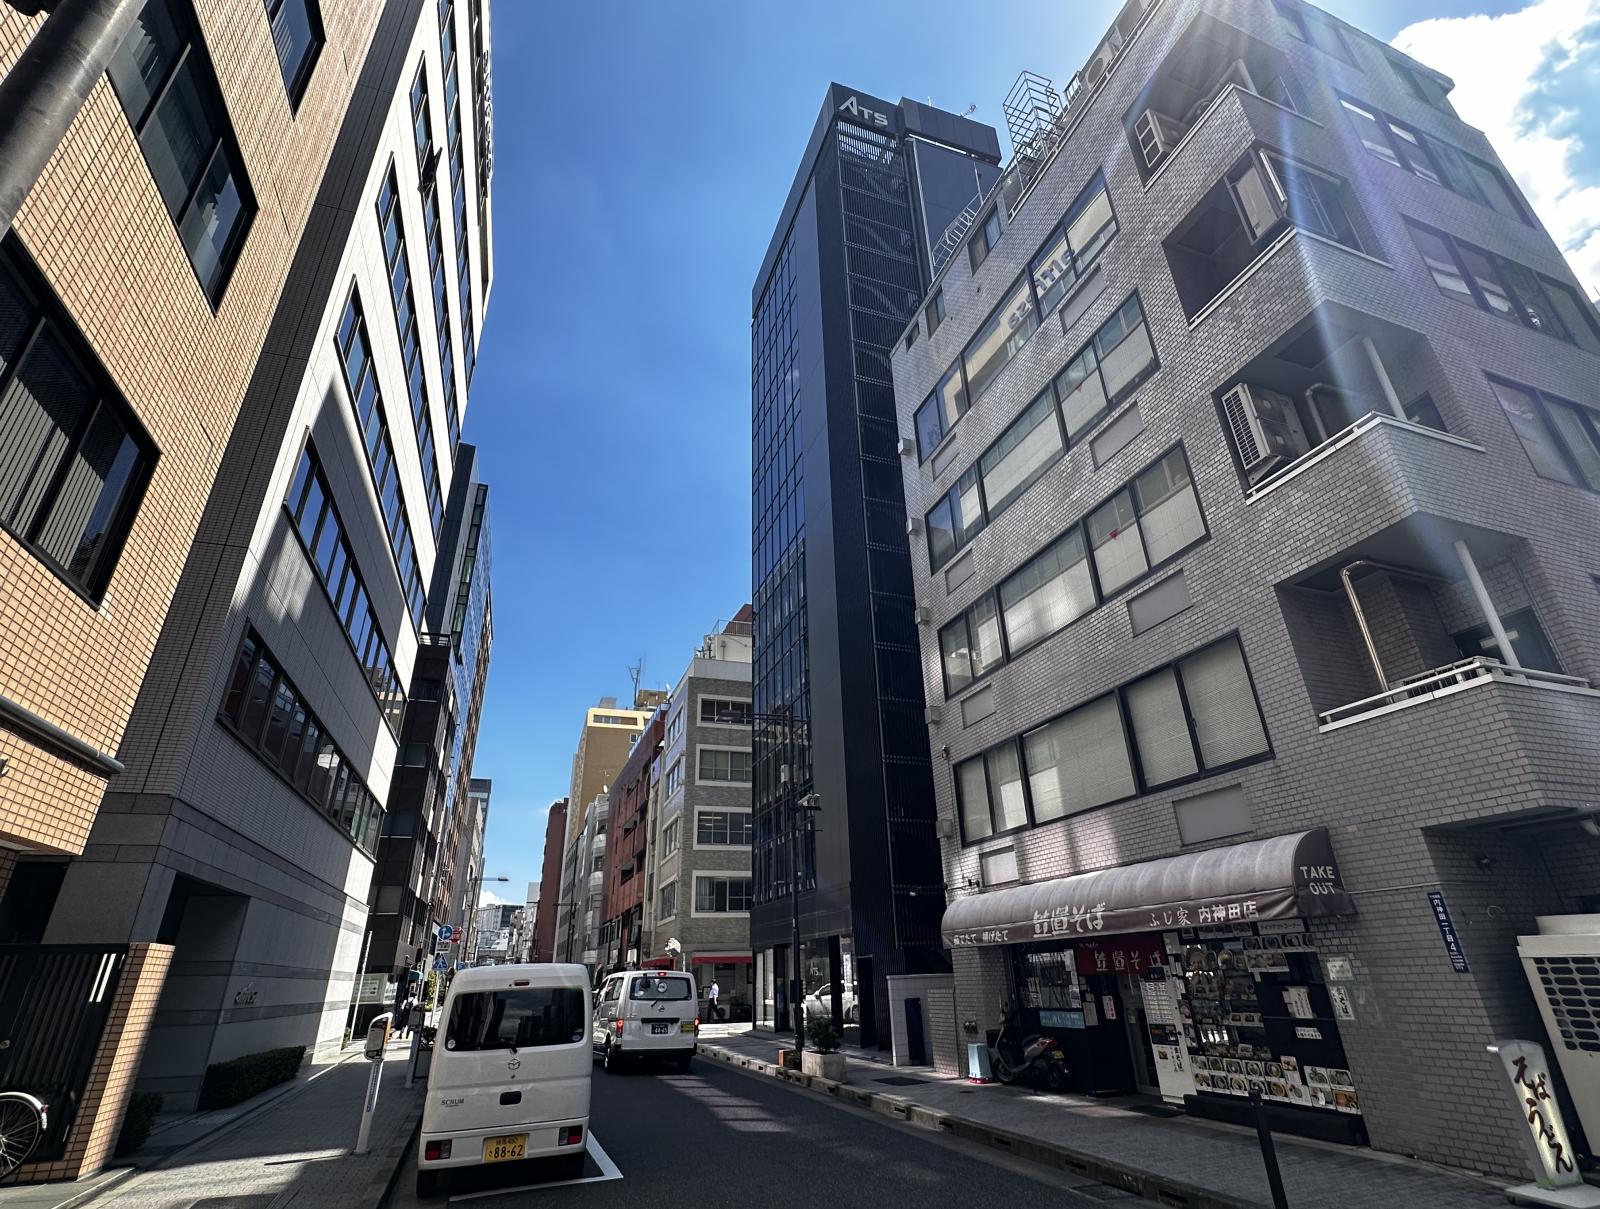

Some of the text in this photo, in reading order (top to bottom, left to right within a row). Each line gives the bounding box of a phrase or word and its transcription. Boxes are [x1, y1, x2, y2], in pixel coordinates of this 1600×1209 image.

[838, 95, 888, 126] ATS
[1300, 865, 1335, 879] TAKE
[1308, 882, 1335, 895] OUT
[1149, 901, 1259, 927] ふじ家 内神田店
[493, 1144, 524, 1159] 88-62
